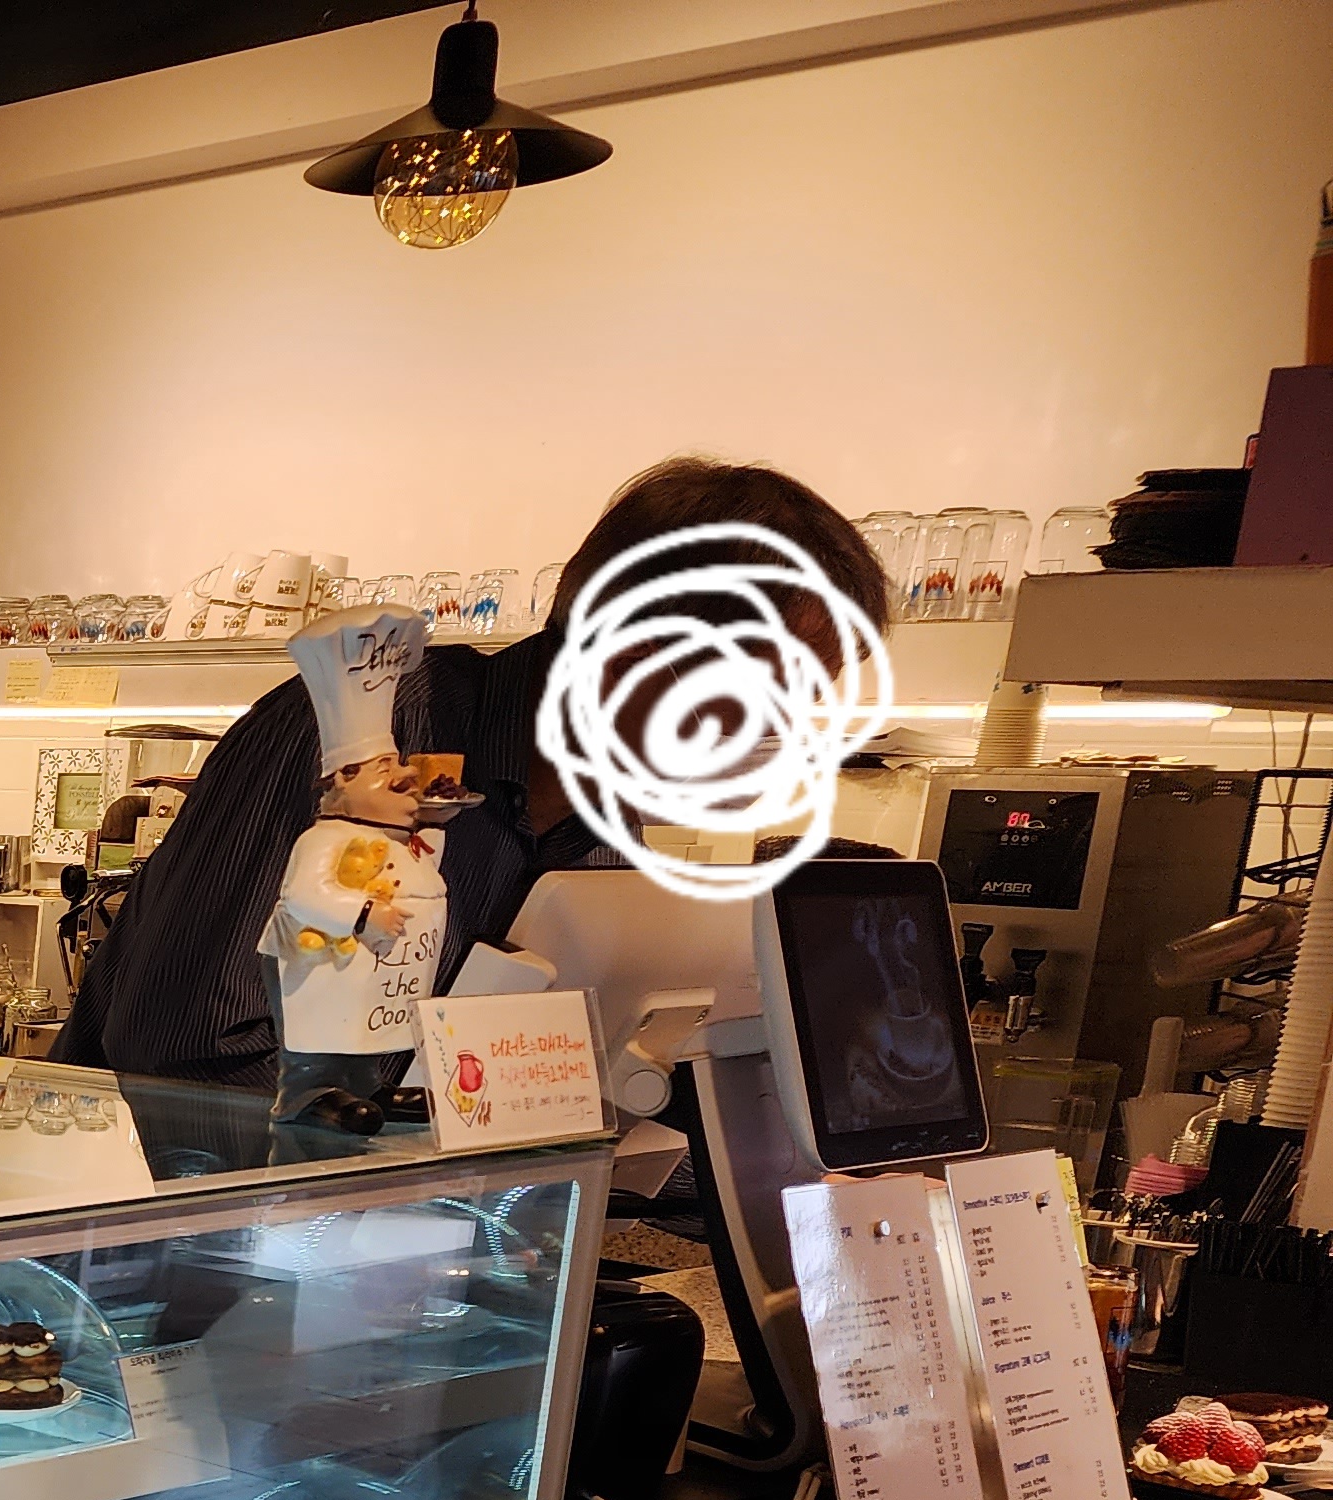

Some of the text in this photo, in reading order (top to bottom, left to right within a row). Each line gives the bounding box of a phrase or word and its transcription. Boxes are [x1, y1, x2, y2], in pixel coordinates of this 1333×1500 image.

[981, 881, 1033, 894] AMBER
[381, 972, 420, 998] the
[367, 1005, 410, 1031] Coo
